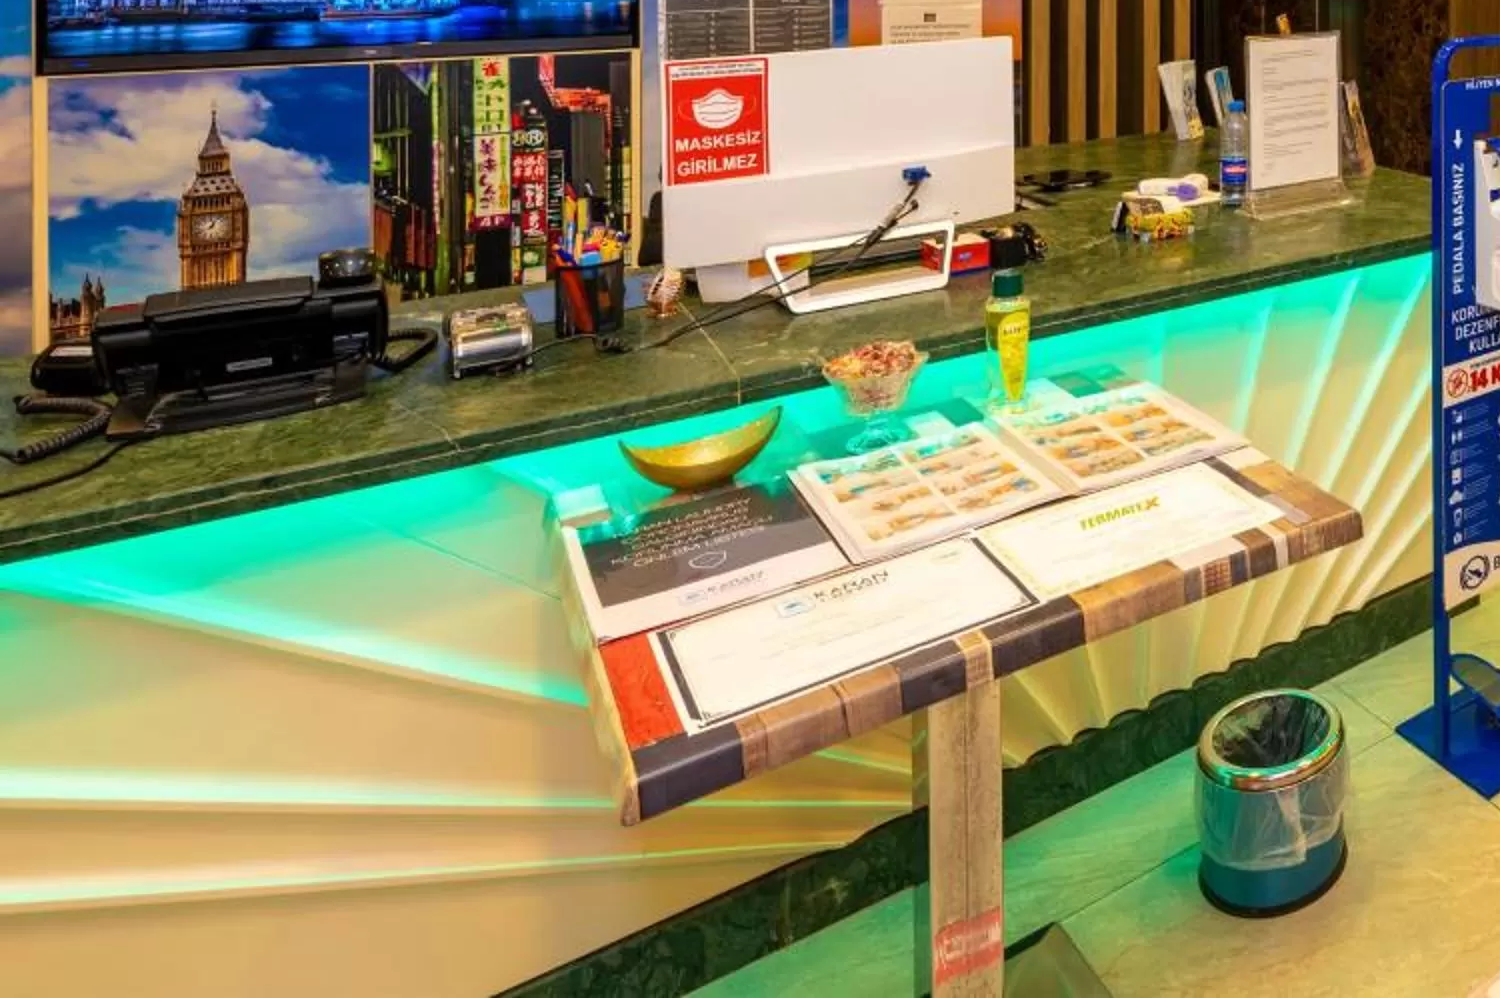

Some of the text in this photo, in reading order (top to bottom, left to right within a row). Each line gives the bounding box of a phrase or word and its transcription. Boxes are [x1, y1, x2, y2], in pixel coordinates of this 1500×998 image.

[675, 129, 762, 153] MASKESİZ
[677, 153, 758, 177] GİRİLMEZ
[1451, 162, 1465, 295] PEDALA BASINIZ
[1470, 368, 1488, 391] 14
